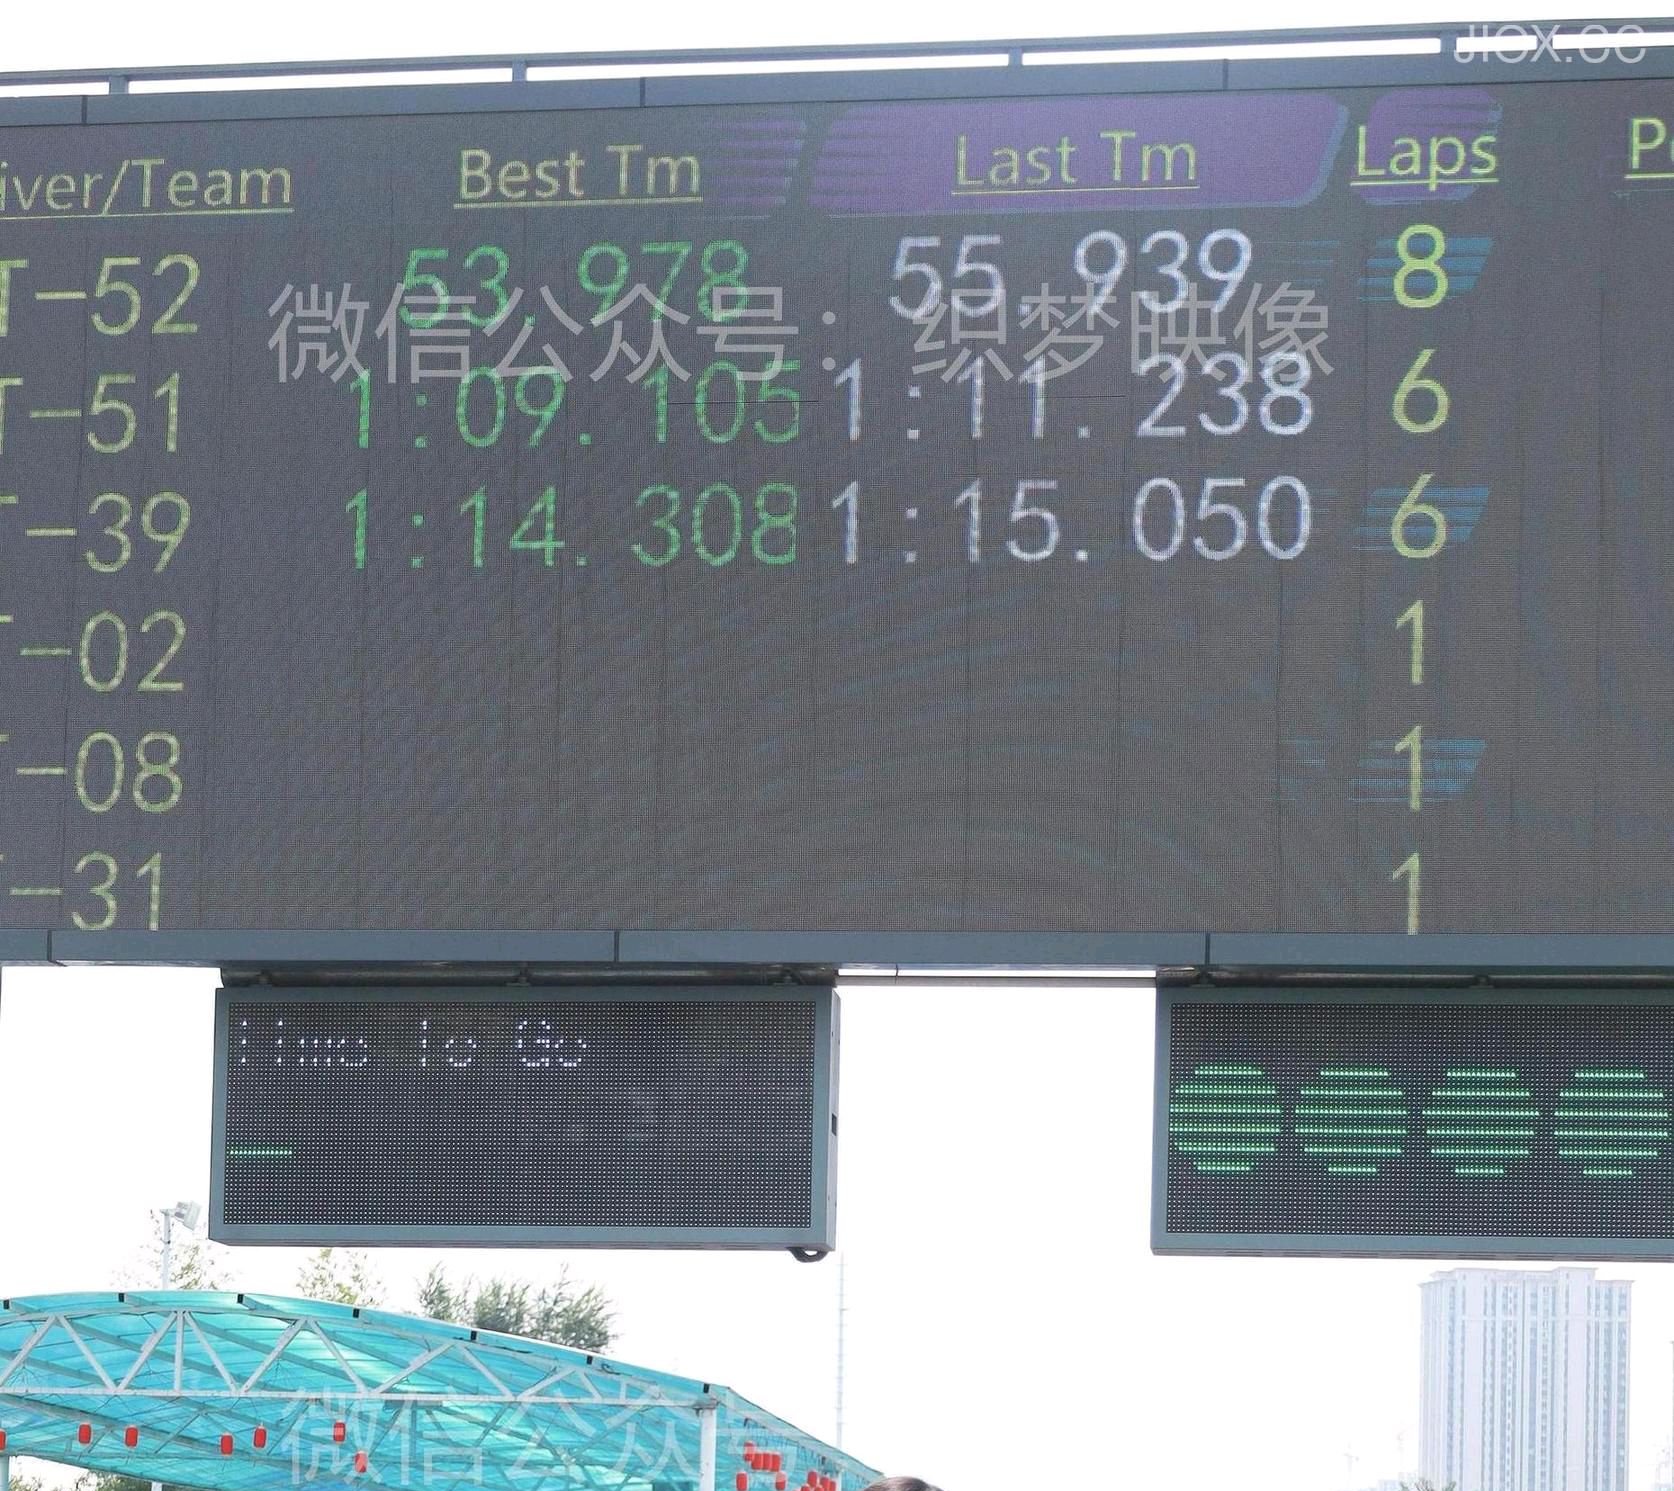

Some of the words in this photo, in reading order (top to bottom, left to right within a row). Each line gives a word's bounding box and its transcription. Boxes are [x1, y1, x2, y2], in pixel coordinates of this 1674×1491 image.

[460, 149, 585, 201] Best
[606, 145, 701, 196] Tm
[957, 134, 1077, 187] Last
[1100, 129, 1198, 182] Tm
[1357, 124, 1498, 192] Laps
[1631, 117, 1674, 170] P
[1392, 224, 1449, 309] 8
[1392, 348, 1450, 433] 6
[0, 491, 192, 572] -39
[1390, 474, 1448, 560] 6
[0, 609, 187, 693] -02
[1395, 599, 1425, 685] 1
[0, 730, 183, 814] -08
[1393, 725, 1423, 811] 1
[0, 851, 163, 932] -31
[1391, 851, 1421, 935] 1
